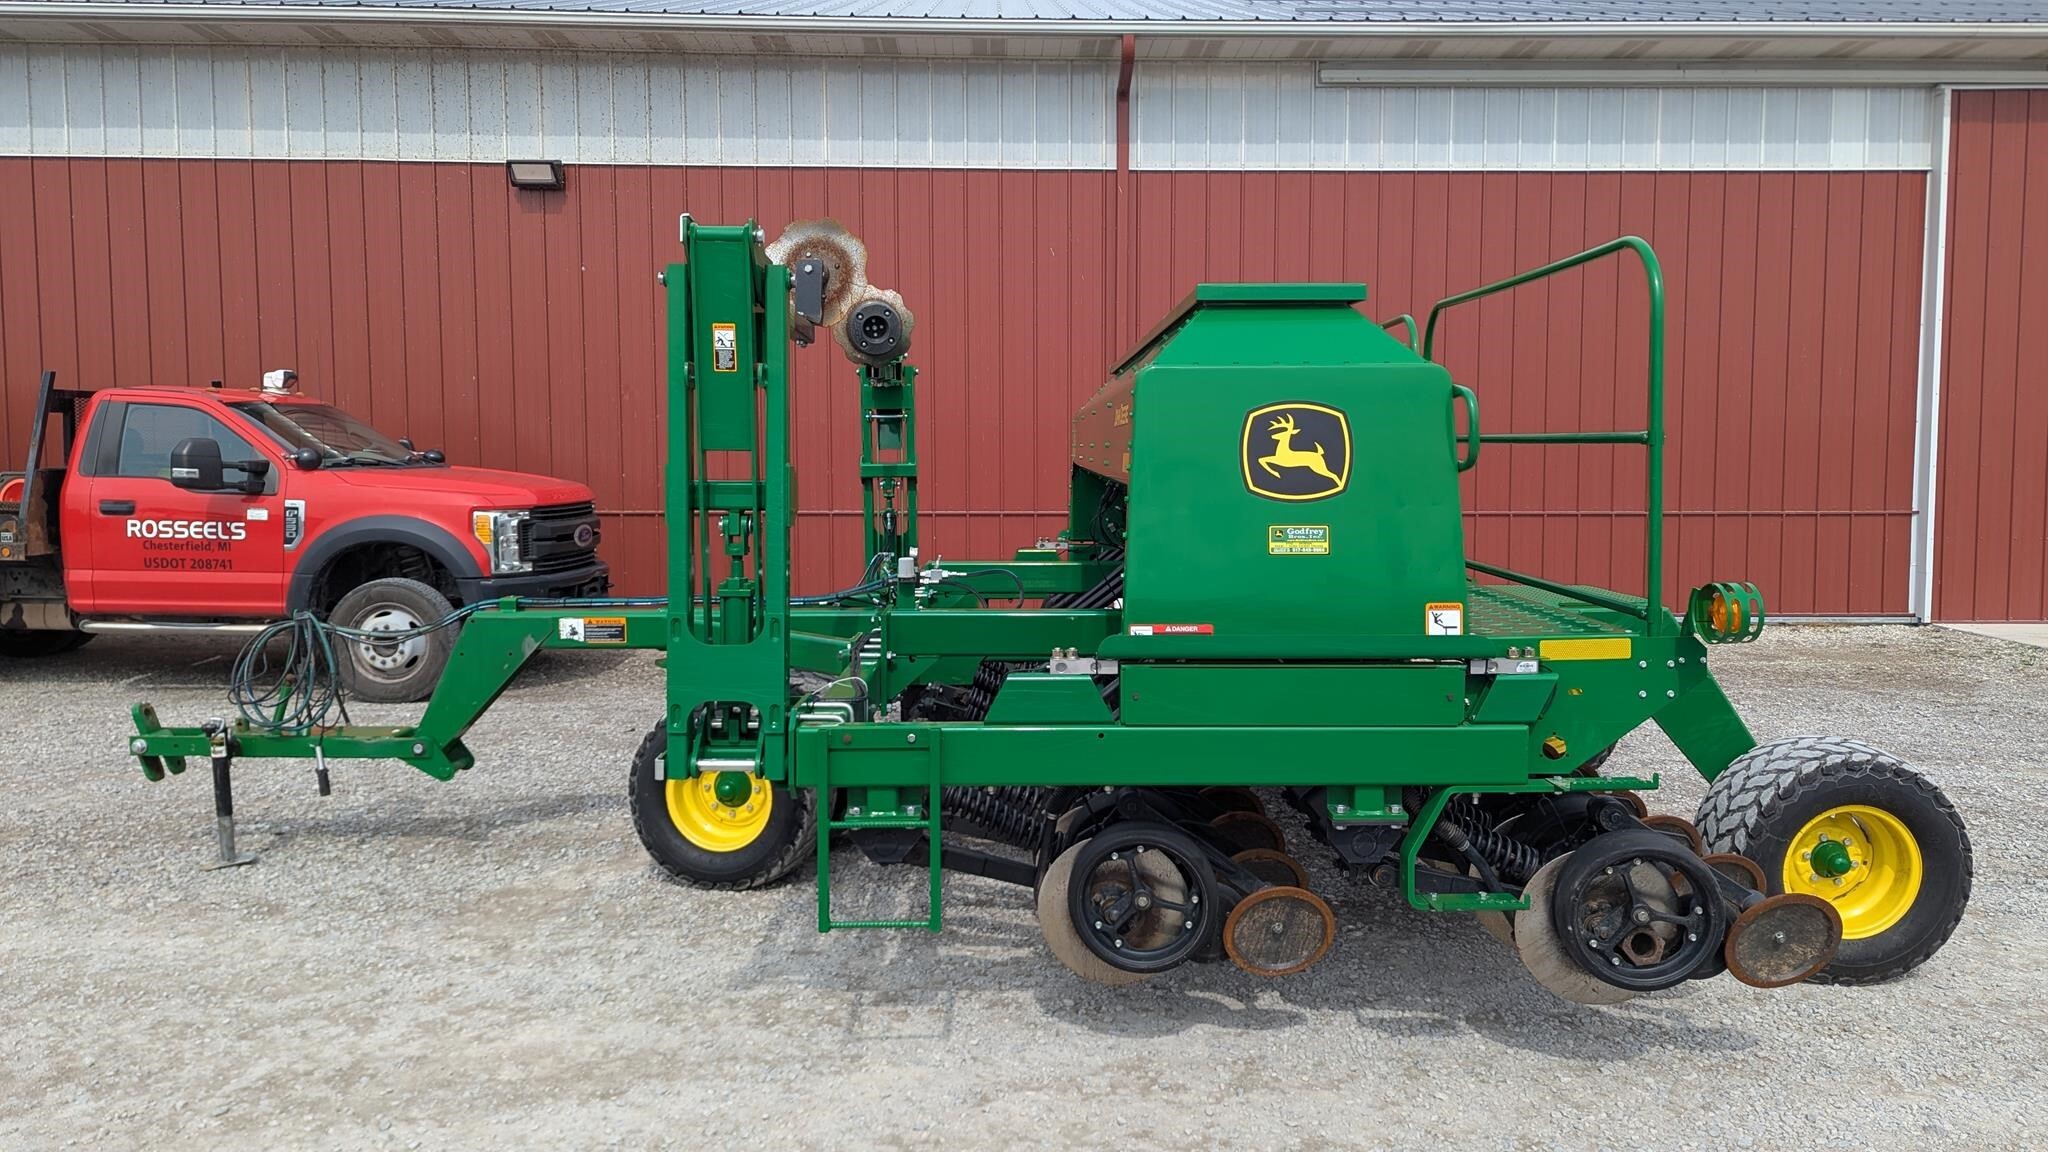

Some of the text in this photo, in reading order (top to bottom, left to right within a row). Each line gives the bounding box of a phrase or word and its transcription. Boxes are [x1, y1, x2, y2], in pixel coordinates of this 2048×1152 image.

[126, 519, 247, 541] ROSSEEL'S
[1286, 528, 1324, 537] Godfrey
[142, 541, 232, 553] Chesterfield, MI
[143, 557, 233, 571] USDOT 208741
[1171, 625, 1199, 633] DANGER
